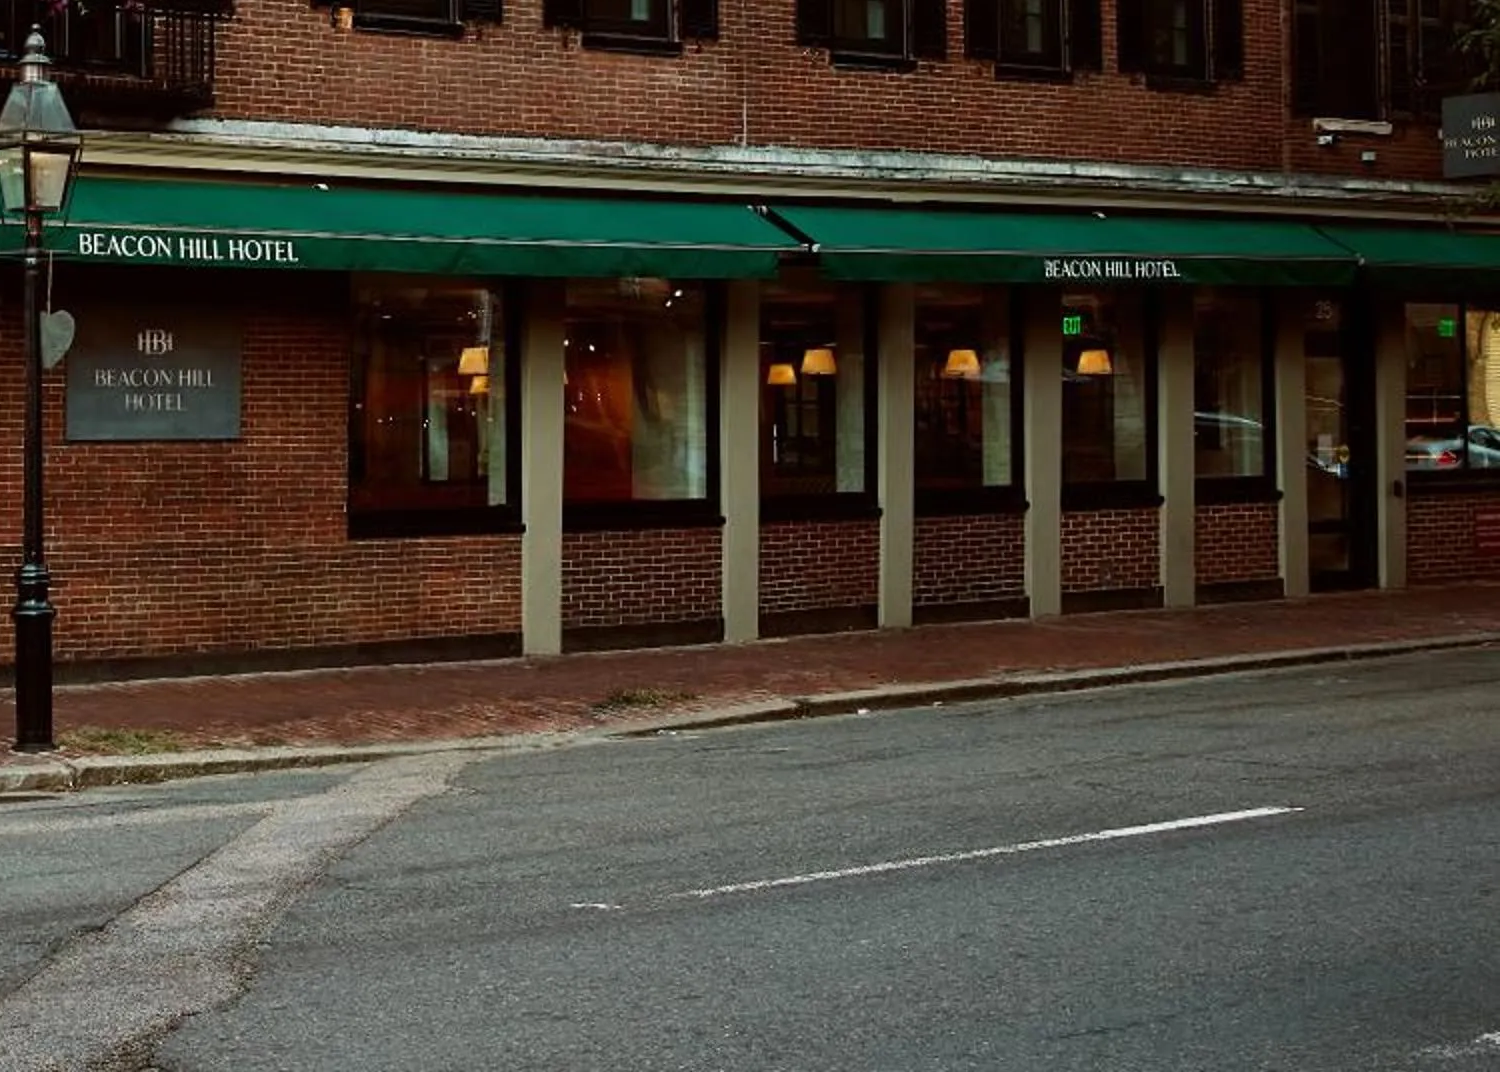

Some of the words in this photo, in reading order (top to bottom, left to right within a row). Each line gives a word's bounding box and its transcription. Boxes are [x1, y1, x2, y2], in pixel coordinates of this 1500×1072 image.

[78, 233, 172, 257] BEACON
[179, 237, 224, 260] HILL
[229, 239, 299, 262] HOTEL
[1043, 259, 1101, 278] BEACON
[1105, 260, 1132, 278] HILL
[1135, 260, 1181, 278] HOTEL
[94, 368, 173, 387] BEACON
[179, 368, 215, 387] HILL
[125, 393, 187, 411] HOTEL
